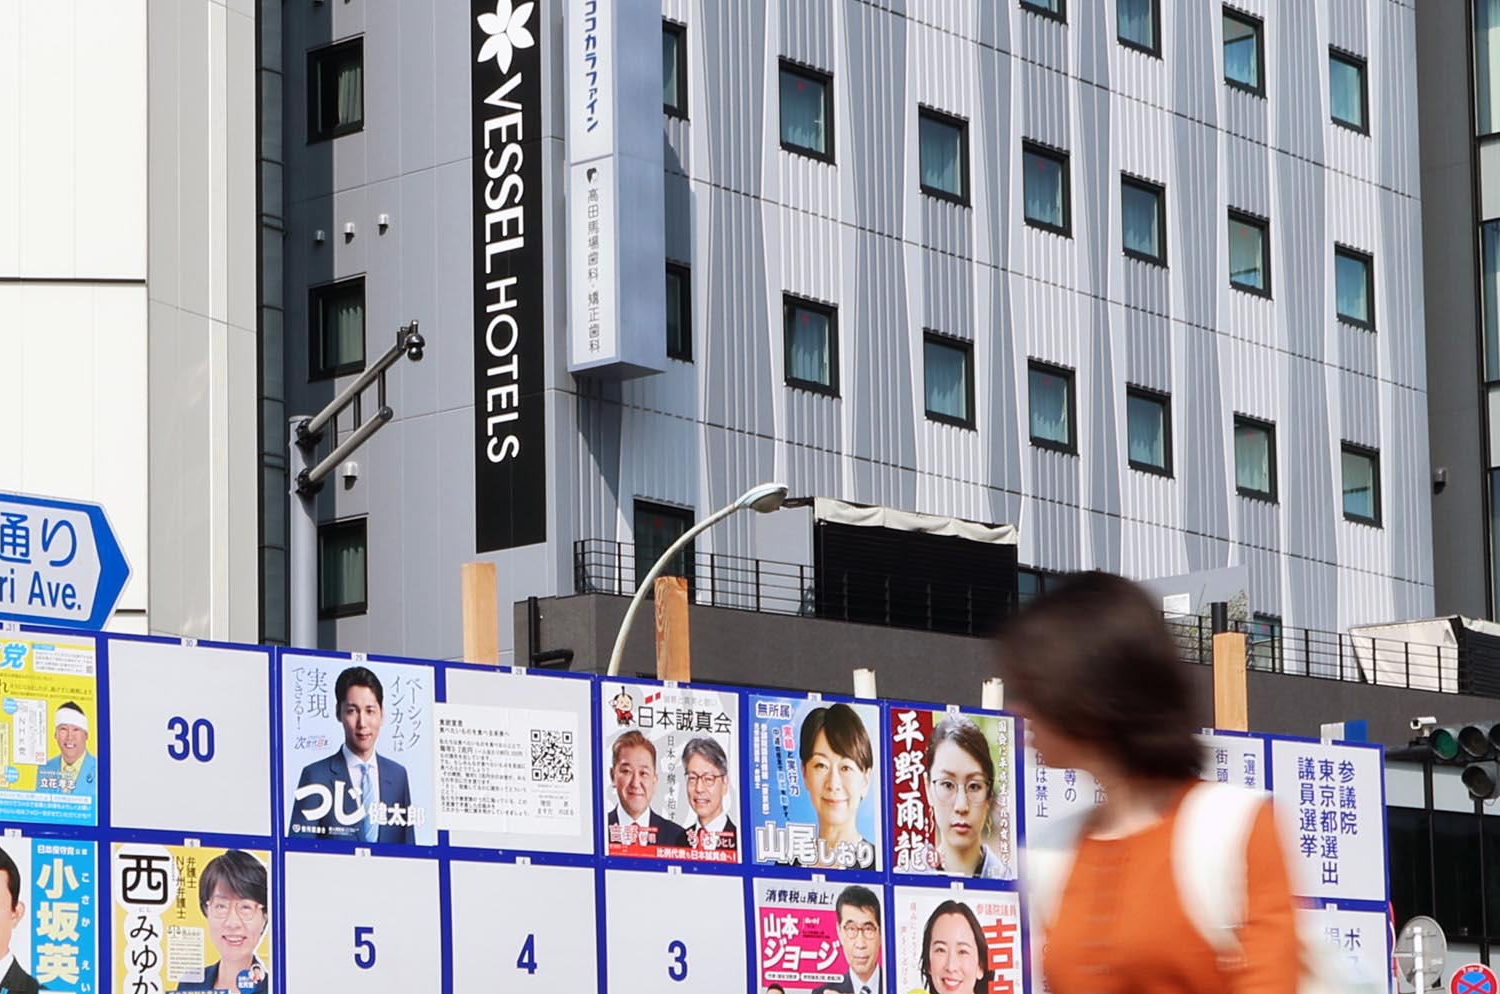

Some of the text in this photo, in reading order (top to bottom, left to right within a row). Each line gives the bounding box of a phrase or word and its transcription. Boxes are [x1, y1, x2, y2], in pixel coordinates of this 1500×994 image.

[484, 72, 524, 463] VESSEL HOTELS
[28, 571, 82, 611] Ave.
[292, 667, 306, 730] できる！
[307, 669, 330, 719] 実現
[391, 676, 405, 753] インカムは
[407, 677, 423, 750] ベーシック
[757, 702, 791, 718] 無所属
[166, 715, 214, 762] 30
[638, 706, 732, 734] 日本誠真会
[294, 780, 366, 826] つじ
[893, 710, 925, 872] 平野雨龍
[1064, 769, 1077, 802] 等の
[1298, 757, 1318, 858] 議員選挙
[1338, 760, 1357, 835] 参議院
[367, 802, 426, 828] 健太郎
[1318, 759, 1339, 885] 東京都選出
[756, 821, 874, 869] 山尾しおり
[119, 854, 170, 905] 西
[186, 856, 196, 889] 弁護士
[81, 872, 91, 928] こさか
[765, 889, 835, 905] 消費税は廃止！
[354, 926, 375, 968] 5
[763, 913, 799, 939] 山本
[516, 933, 537, 973] 4
[667, 939, 687, 981] 3
[763, 938, 840, 971] ジョージ
